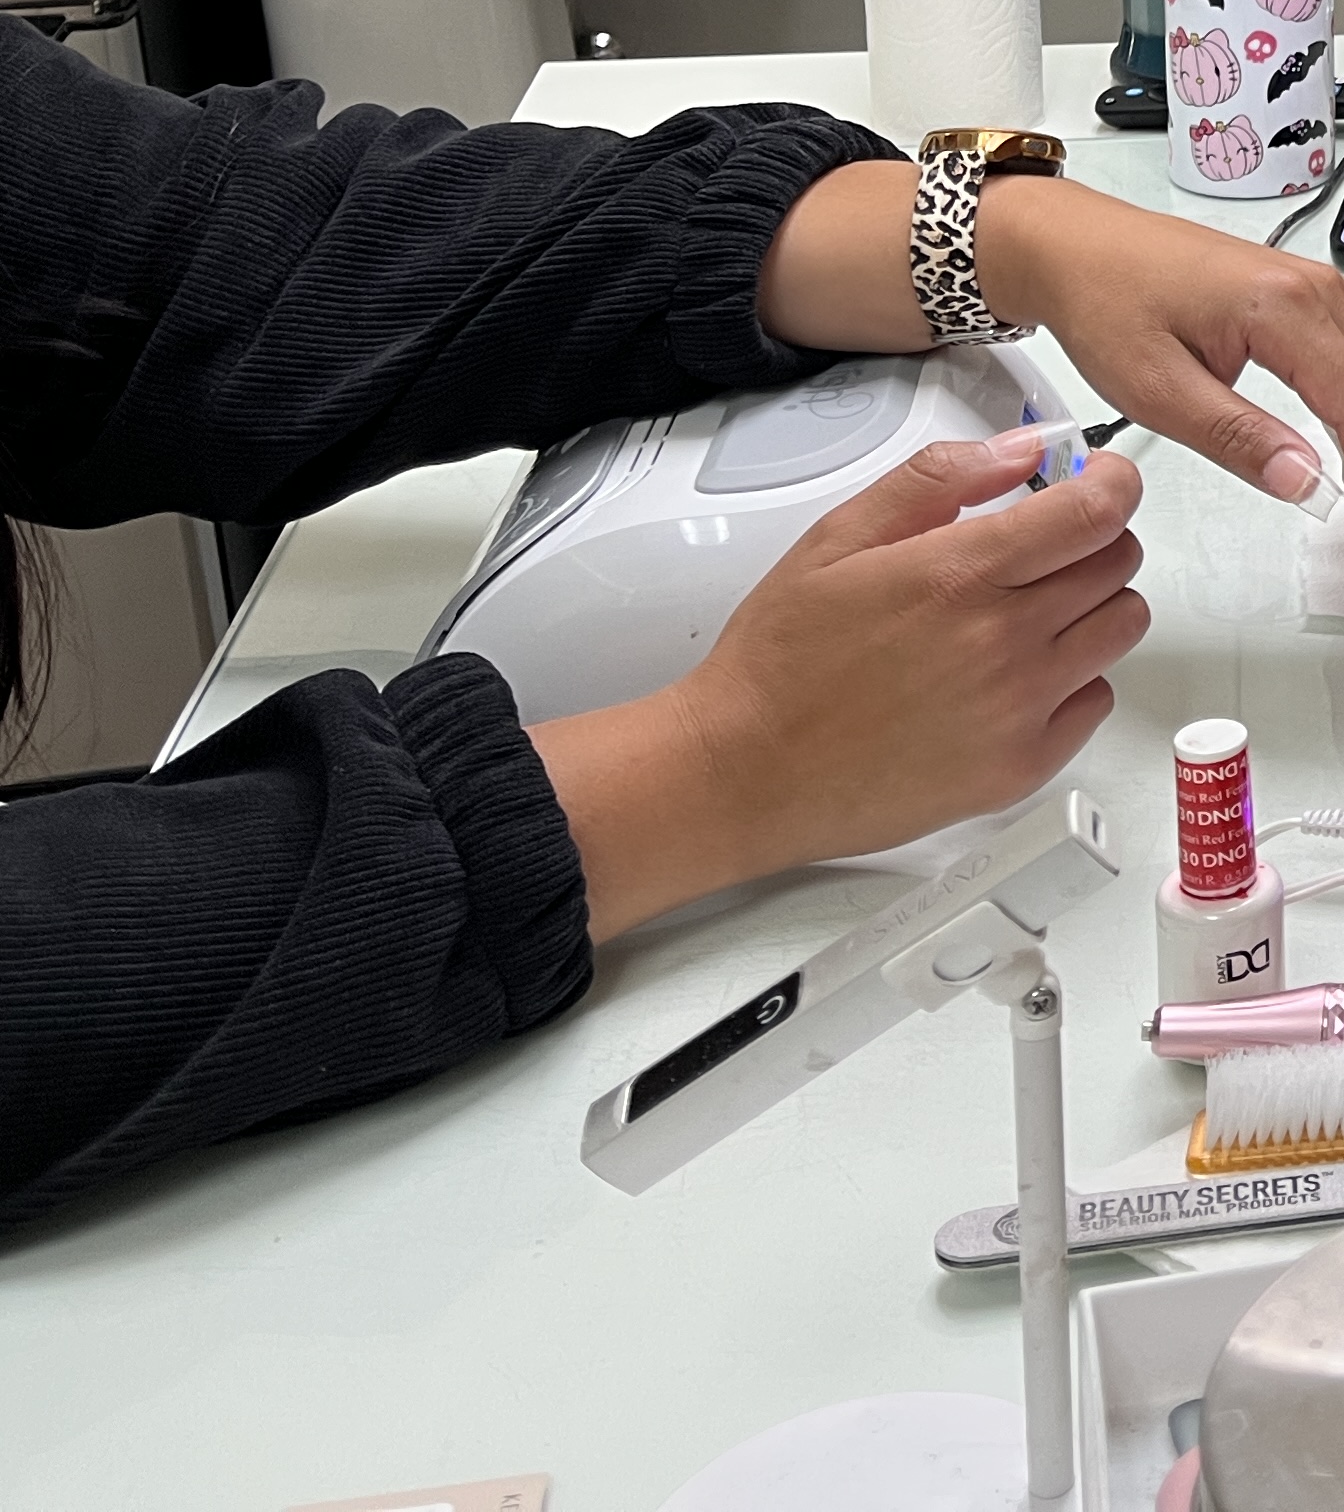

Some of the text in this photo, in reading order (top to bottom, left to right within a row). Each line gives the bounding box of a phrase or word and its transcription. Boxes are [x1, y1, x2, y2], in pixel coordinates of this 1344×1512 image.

[1199, 791, 1223, 804] Red
[1202, 831, 1225, 846] Red
[1078, 1189, 1189, 1223] BEAUTY
[1079, 1192, 1321, 1234] SUPERIOR NAIL PRODUCTS
